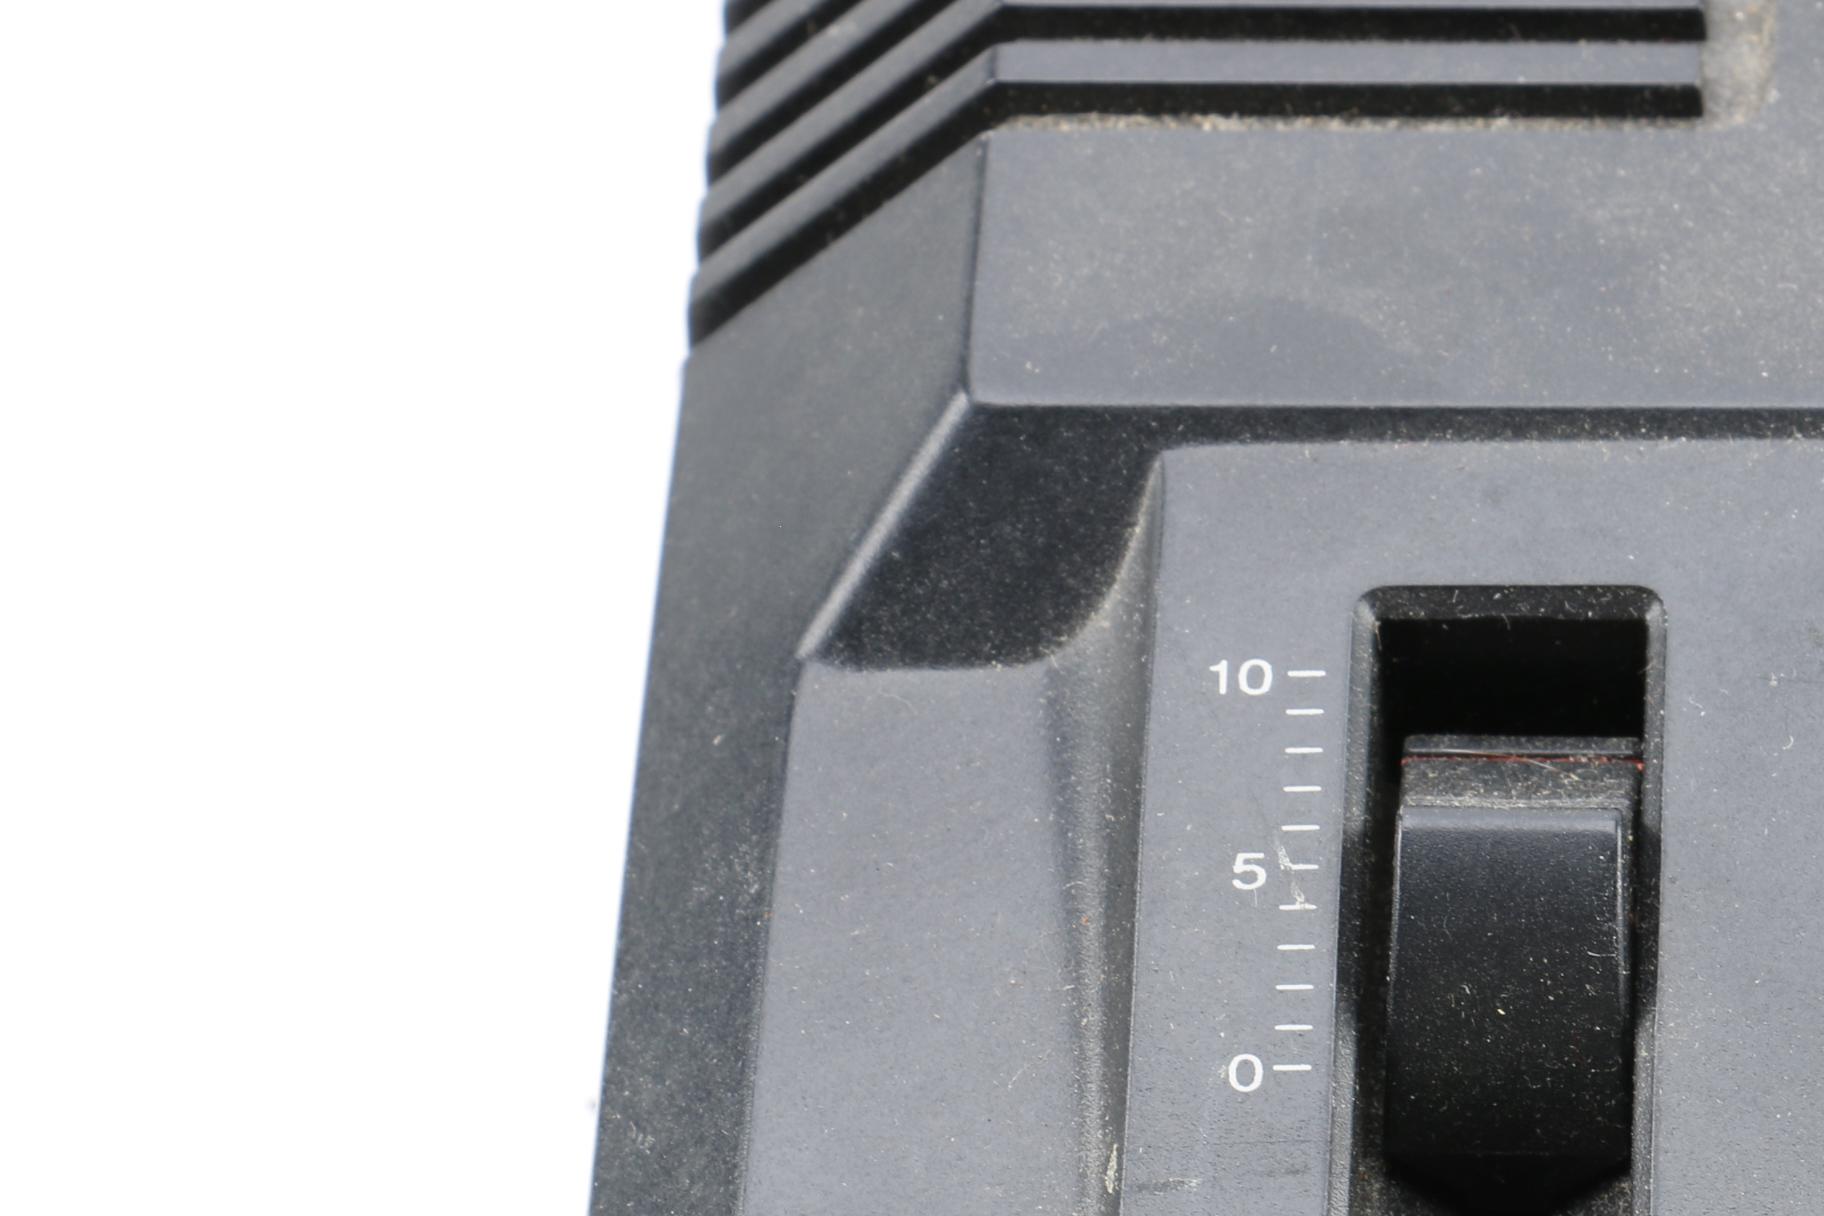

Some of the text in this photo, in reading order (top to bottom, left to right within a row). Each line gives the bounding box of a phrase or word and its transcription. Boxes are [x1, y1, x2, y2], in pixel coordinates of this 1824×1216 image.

[1208, 657, 1275, 697] 10
[1231, 852, 1268, 891] 5
[1227, 1052, 1265, 1094] 0
